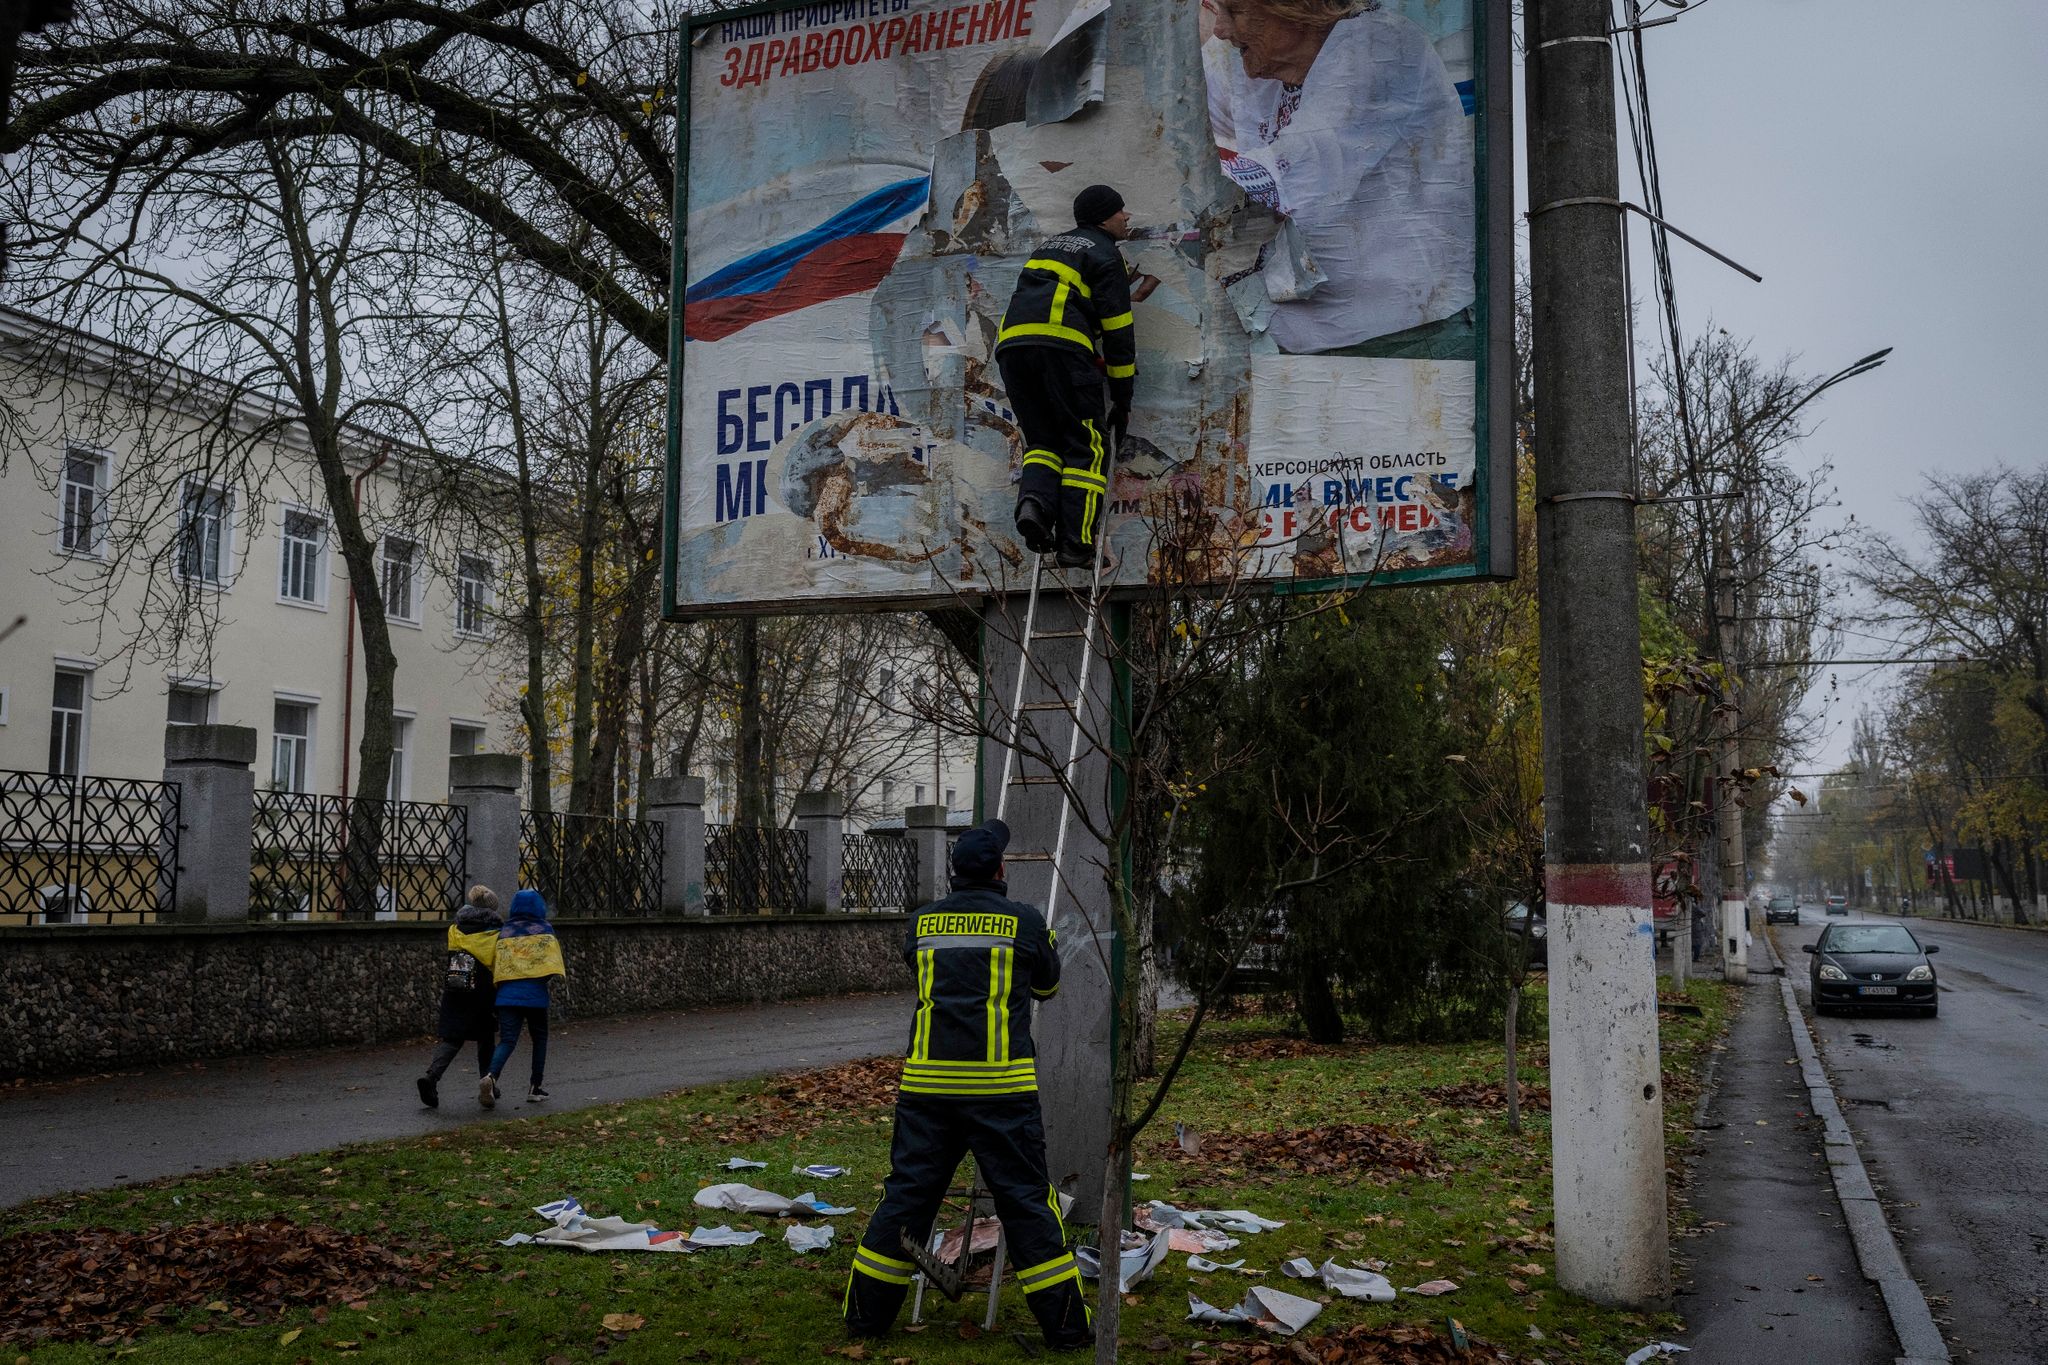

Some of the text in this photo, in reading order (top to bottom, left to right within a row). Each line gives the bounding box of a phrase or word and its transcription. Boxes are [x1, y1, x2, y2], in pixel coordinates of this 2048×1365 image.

[722, 13, 777, 43] НАШИ
[720, 0, 1035, 89] ЗДРАВООХРАНЕНИЕ
[1254, 451, 1447, 477] ХЕРСОНСКАЯ ОБЛАСТЬ
[919, 915, 1015, 936] FEUERWEHR
